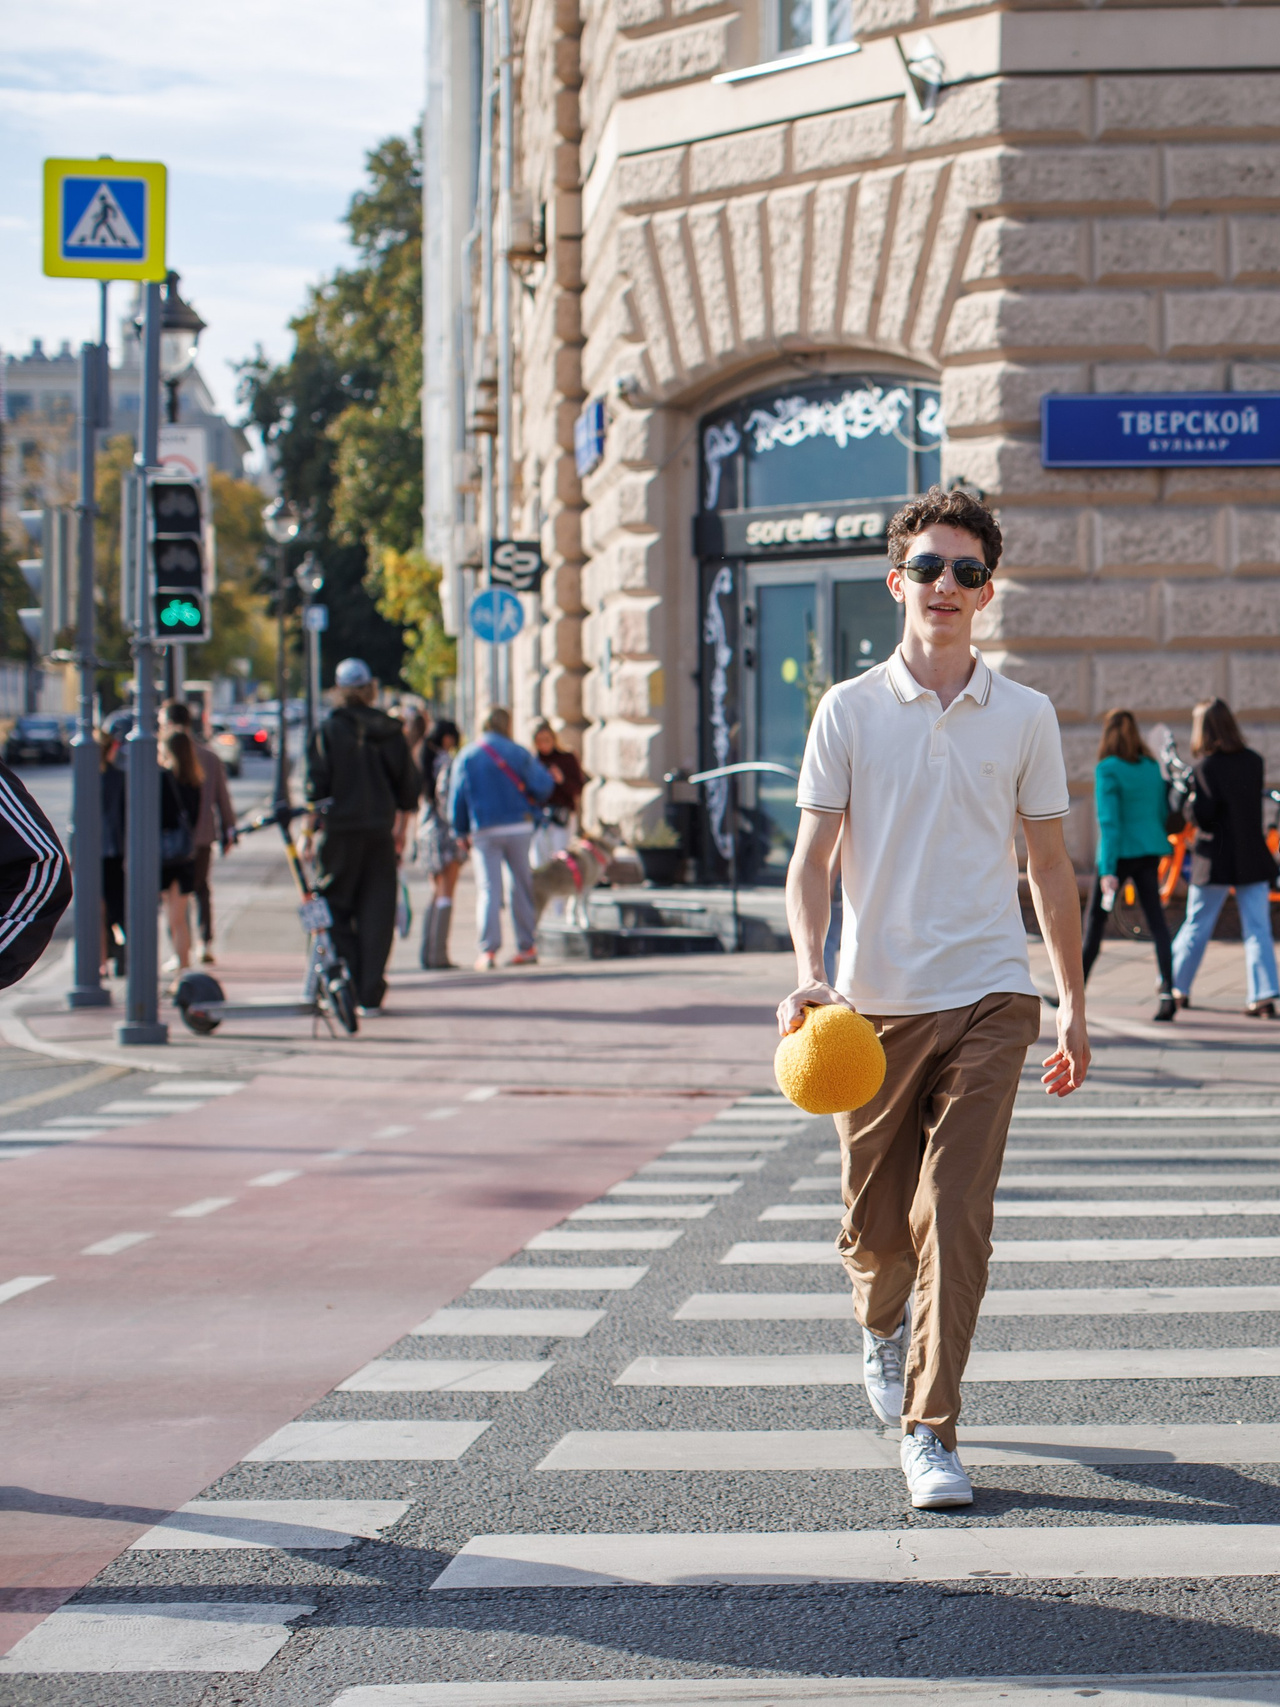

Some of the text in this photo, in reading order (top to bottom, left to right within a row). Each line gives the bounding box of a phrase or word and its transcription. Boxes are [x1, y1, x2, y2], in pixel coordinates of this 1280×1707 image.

[1118, 405, 1259, 435] ТВЕРСКОЙ
[1149, 437, 1230, 452] БУЛЬВАР
[746, 512, 884, 545] sorelle era
